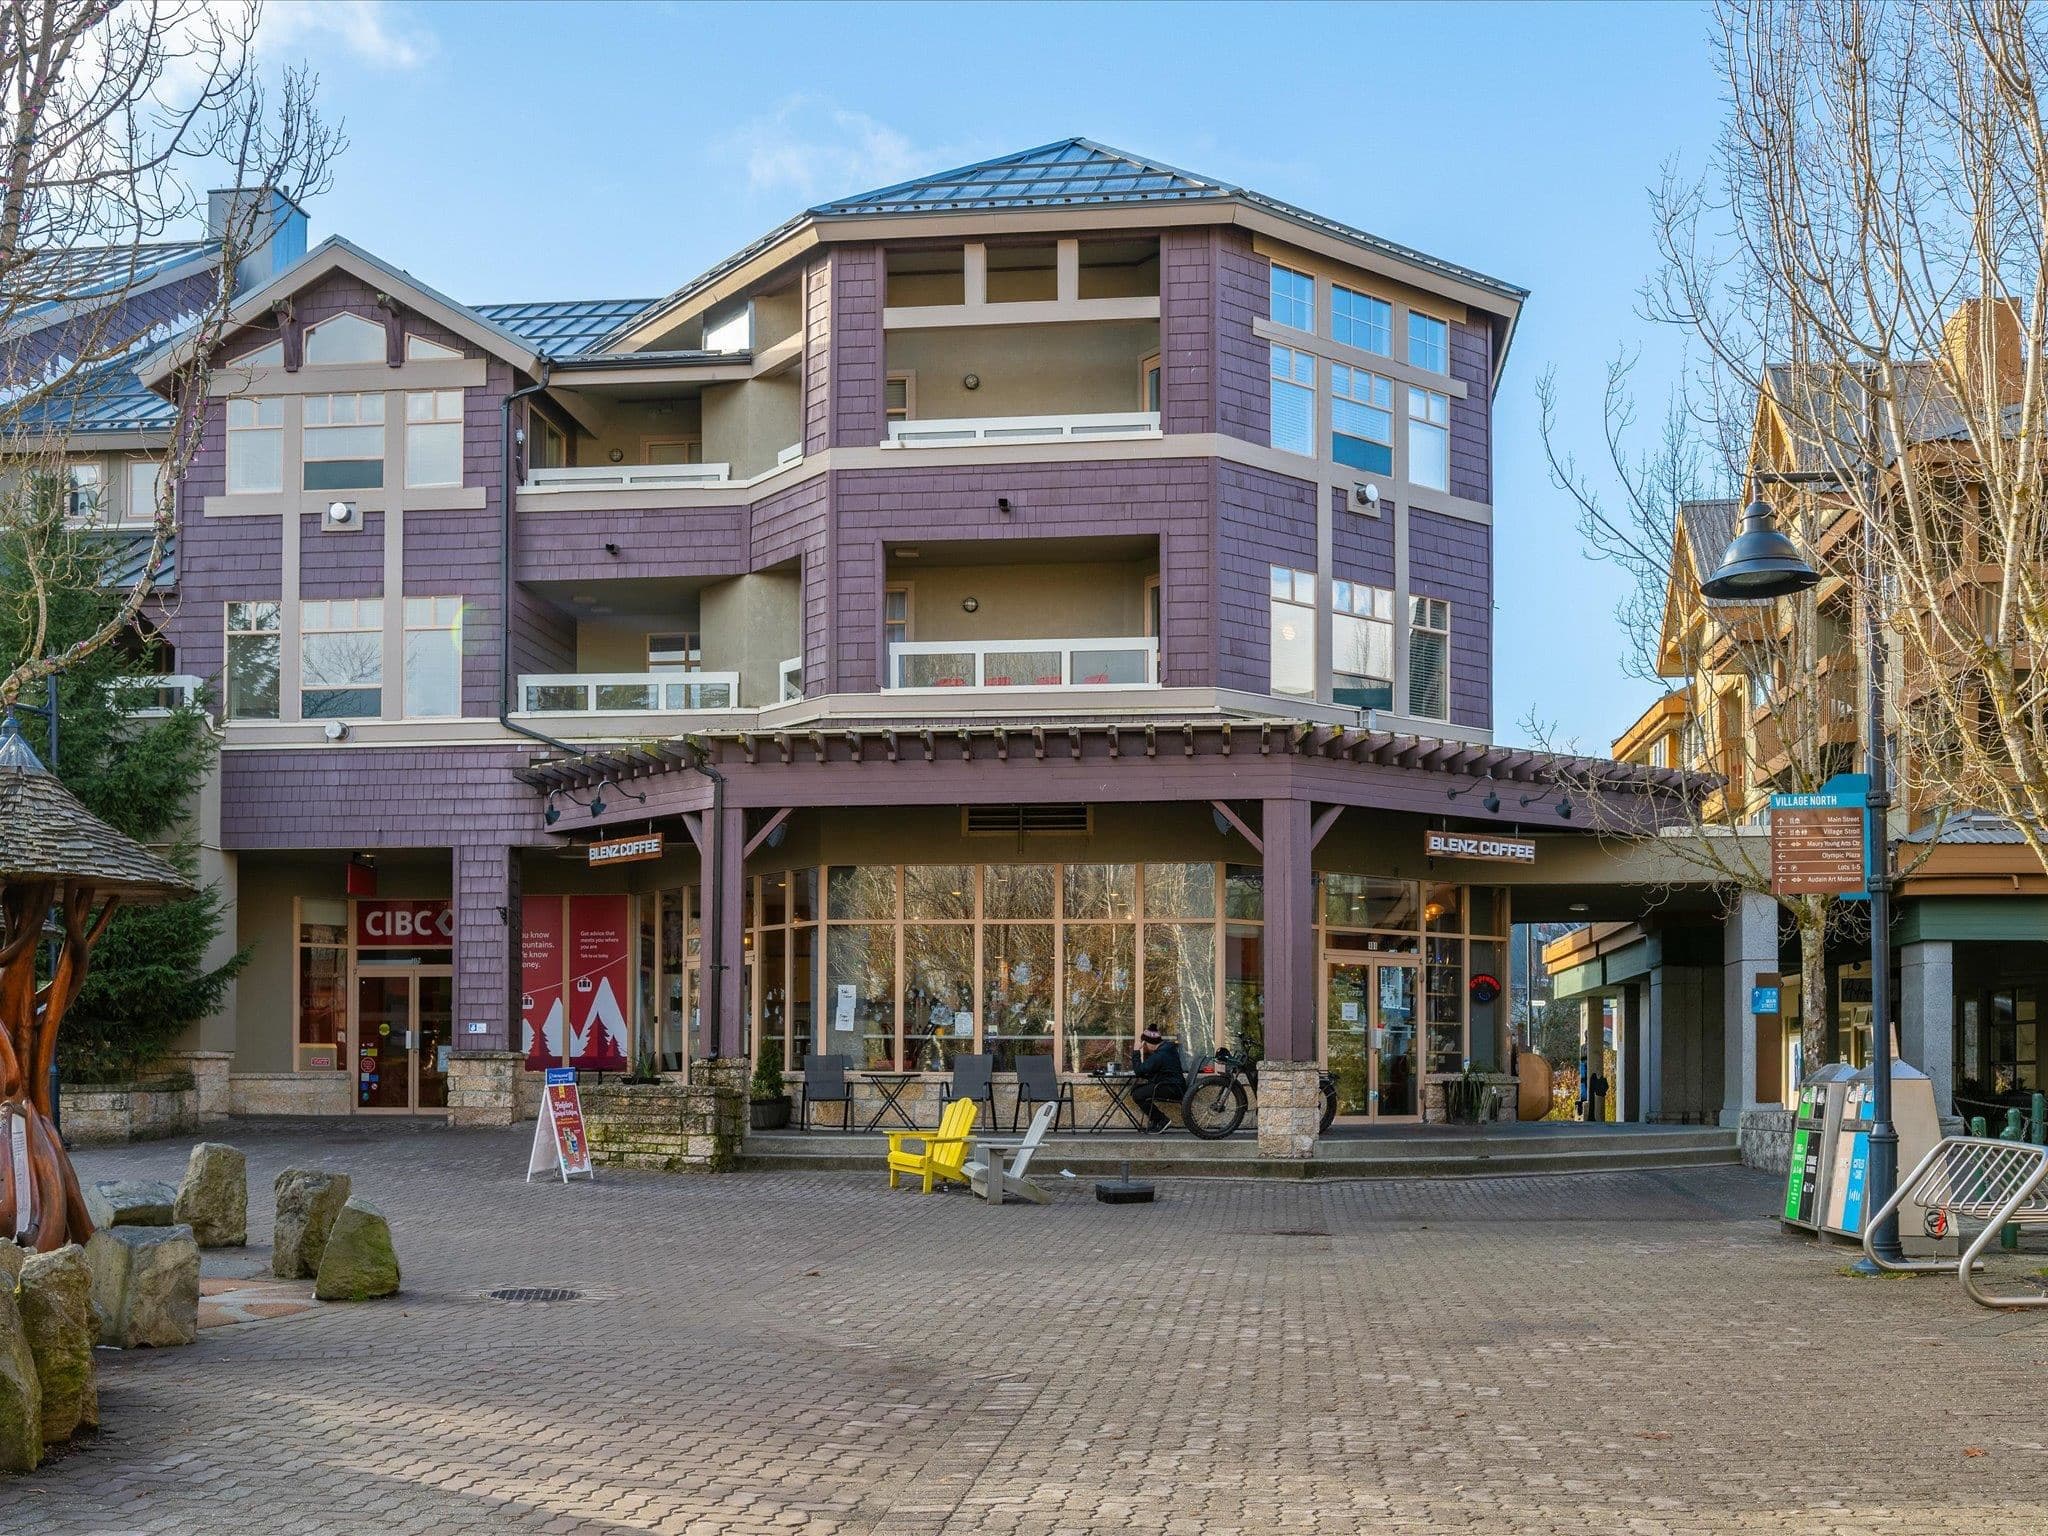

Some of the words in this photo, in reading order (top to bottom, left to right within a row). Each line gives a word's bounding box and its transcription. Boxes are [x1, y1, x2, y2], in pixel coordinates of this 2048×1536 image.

[1775, 796, 1808, 807] VILLAGE
[1809, 795, 1837, 806] NORTH
[1823, 828, 1843, 836] Village
[589, 844, 620, 861] BLENZ
[620, 839, 661, 857] COFFEE
[1429, 836, 1478, 854] BLENZ
[1479, 841, 1535, 858] COFFEE
[365, 910, 433, 936] CIBC
[530, 931, 550, 939] know
[522, 941, 555, 949] ountains.
[522, 961, 541, 969] oney.
